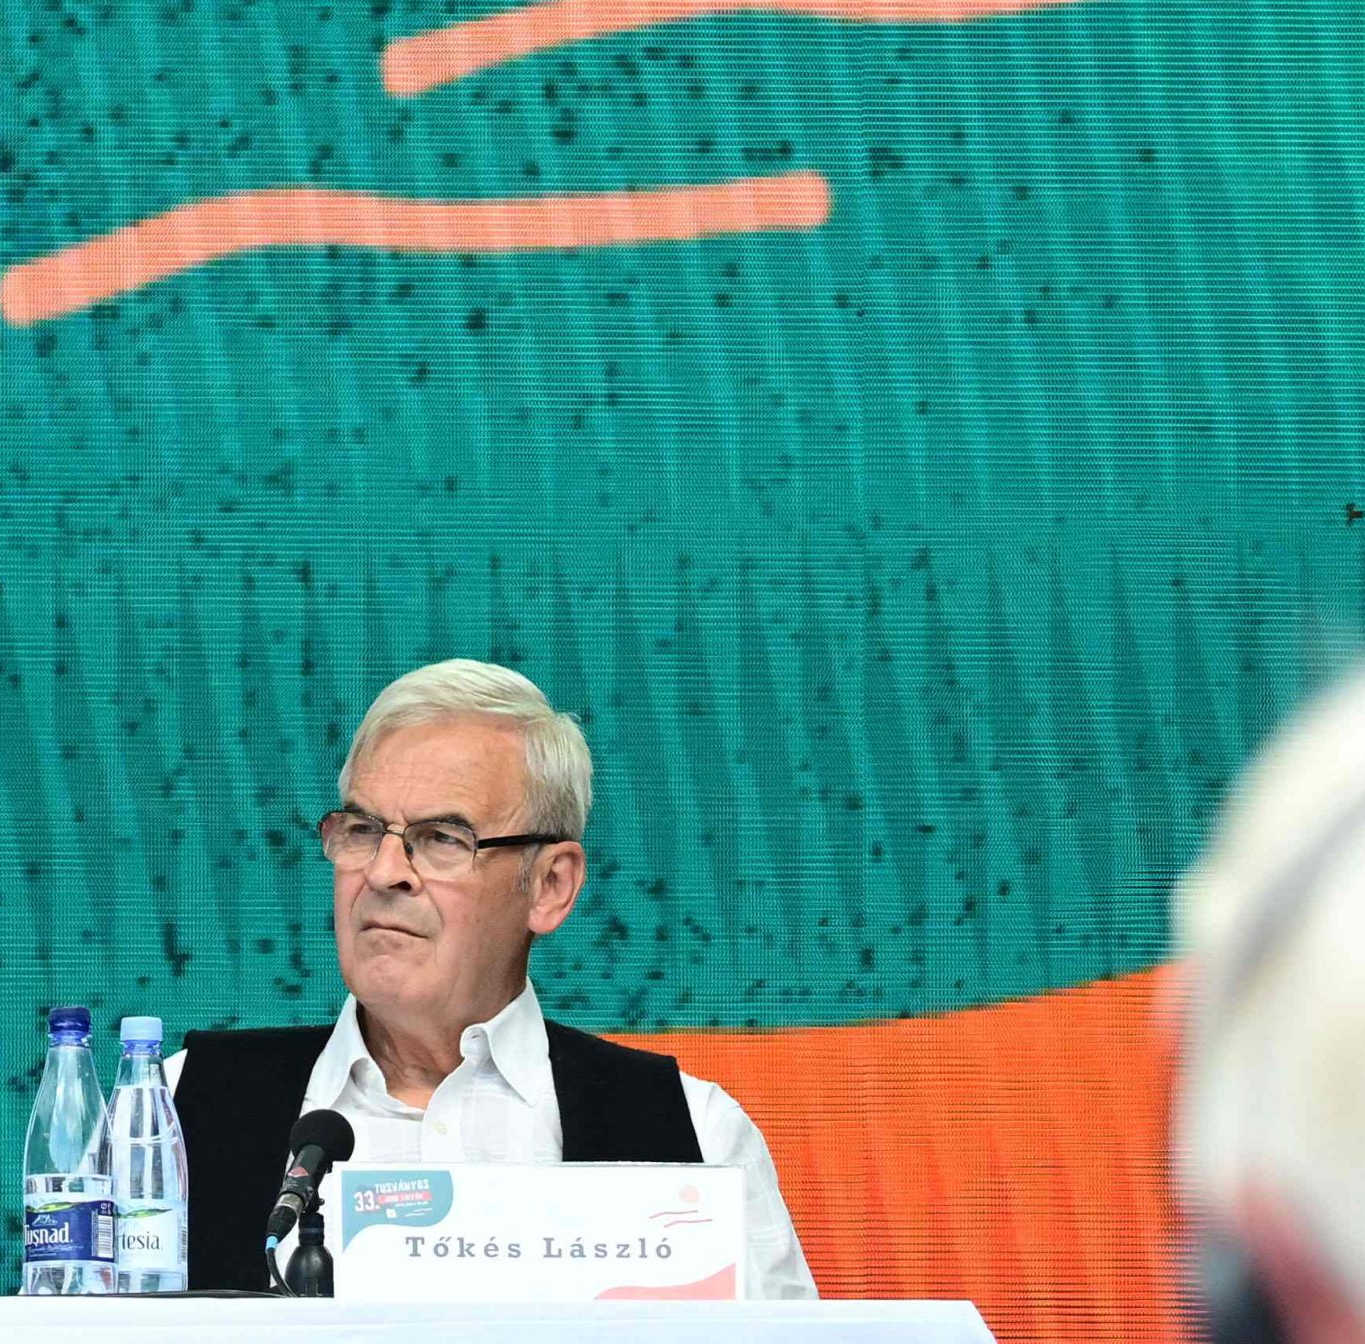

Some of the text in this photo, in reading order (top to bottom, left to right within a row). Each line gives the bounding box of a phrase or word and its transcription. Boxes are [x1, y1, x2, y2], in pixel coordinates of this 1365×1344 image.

[353, 1190, 381, 1212] 33.
[405, 1235, 673, 1260] Tőkés László
